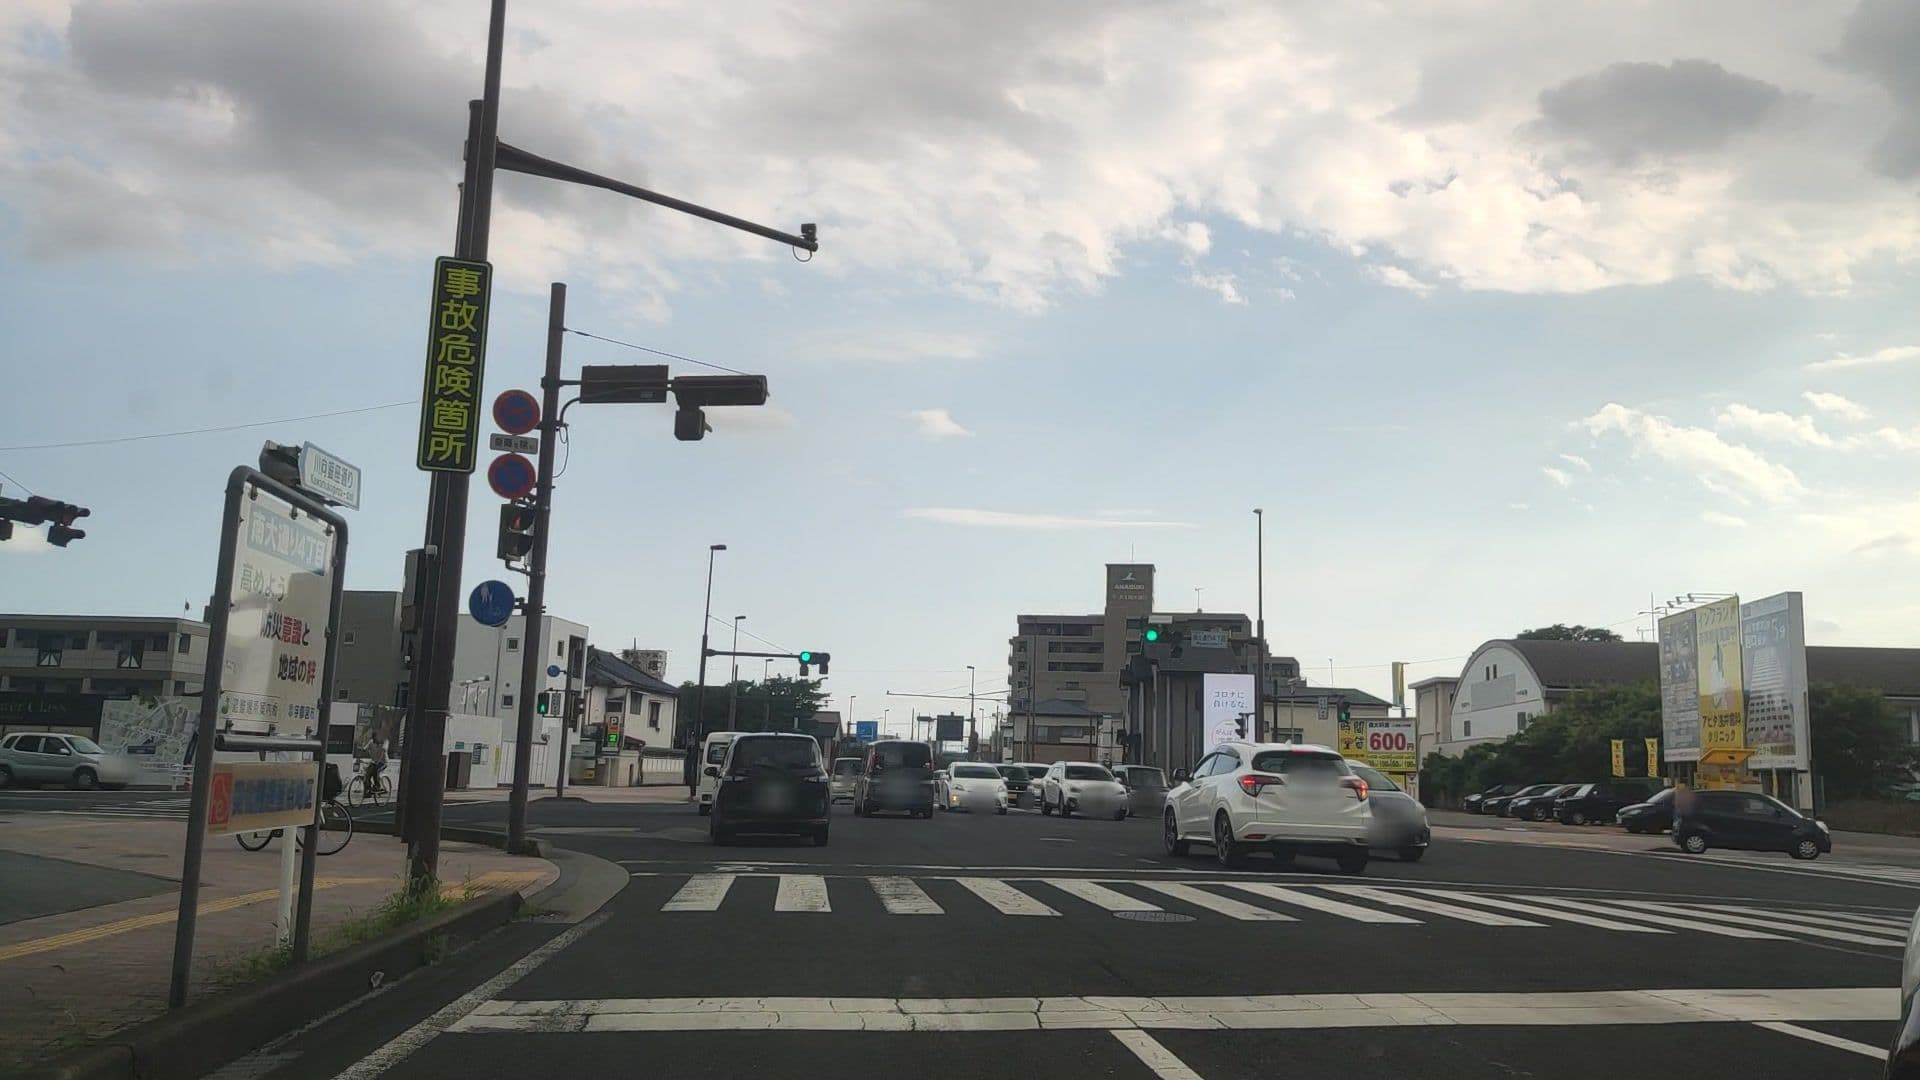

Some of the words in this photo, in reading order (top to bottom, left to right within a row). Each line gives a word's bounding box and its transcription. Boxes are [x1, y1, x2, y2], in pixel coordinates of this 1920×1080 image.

[427, 268, 482, 465] 事故危険箇所
[241, 562, 285, 602] 高めよう
[260, 611, 311, 647] 防災意識と
[277, 653, 317, 686] 地域の絆
[1214, 691, 1245, 699] コロナに
[1707, 730, 1736, 743] クリニック
